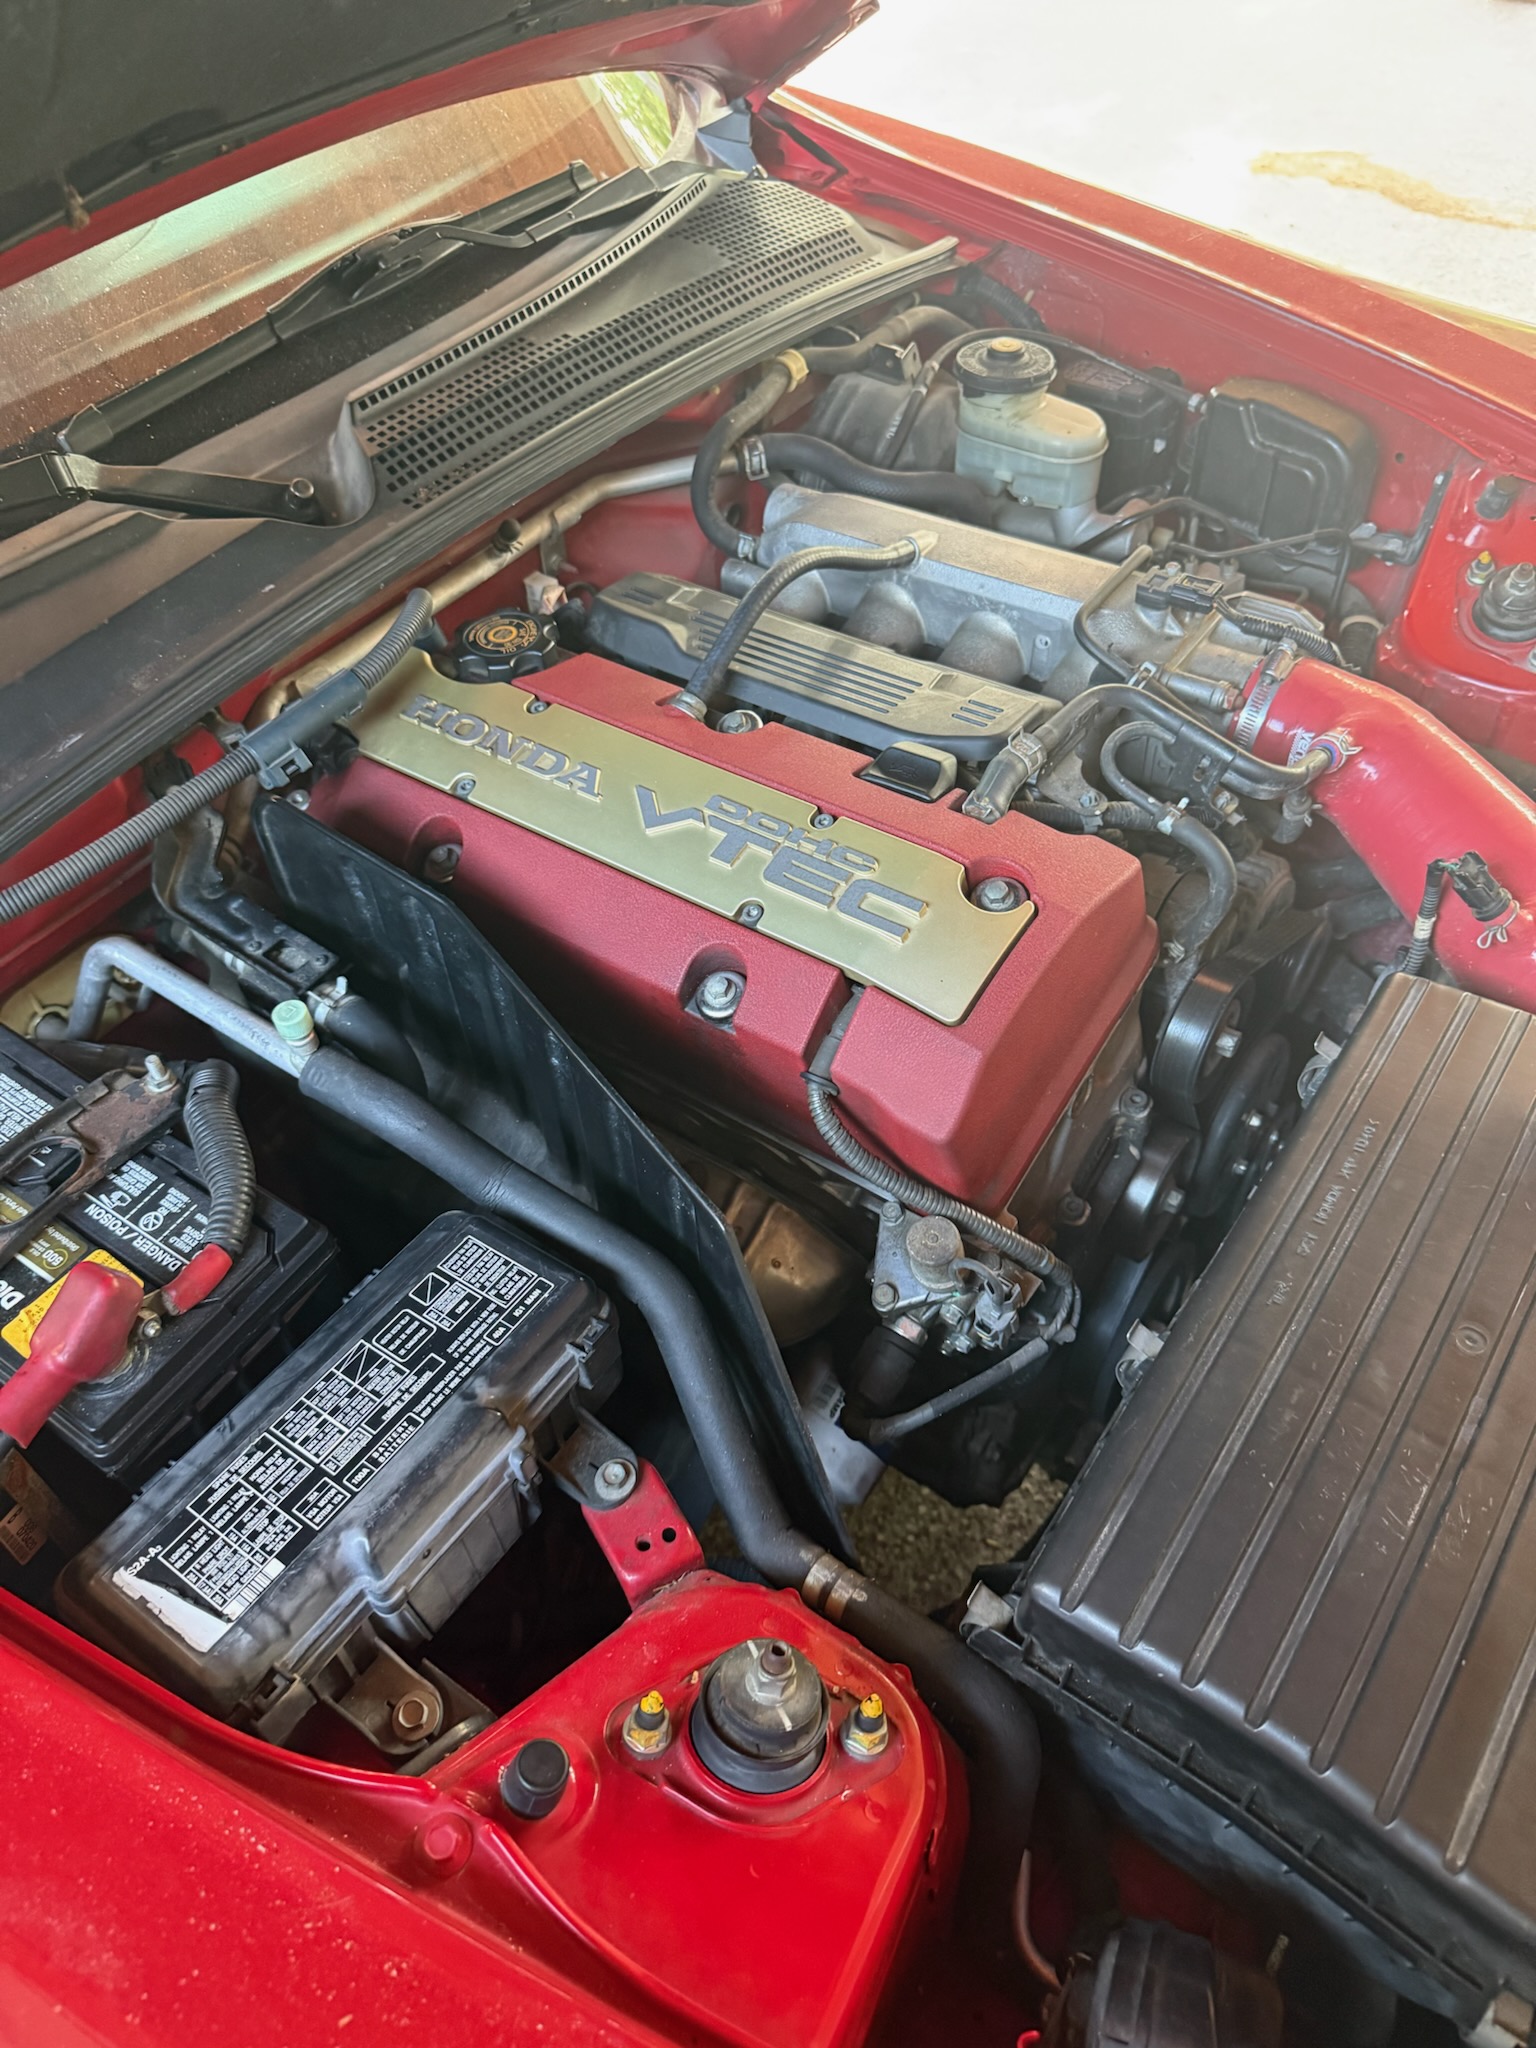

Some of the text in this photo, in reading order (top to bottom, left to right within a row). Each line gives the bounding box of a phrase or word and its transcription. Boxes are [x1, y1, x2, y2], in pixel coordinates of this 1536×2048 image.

[400, 694, 604, 803] HONDA
[703, 794, 879, 876] DOHC
[635, 784, 929, 946] VTEC
[84, 1203, 130, 1236] POISON
[131, 1235, 182, 1272] DANGER
[168, 1235, 193, 1254] SHIELD
[524, 1288, 541, 1305] MAIN
[492, 1326, 506, 1339] 40A
[372, 1421, 408, 1458] BATTERY
[378, 1425, 415, 1462] BATTERIE
[351, 1468, 370, 1484] 100A
[317, 1488, 337, 1507] MOTOR
